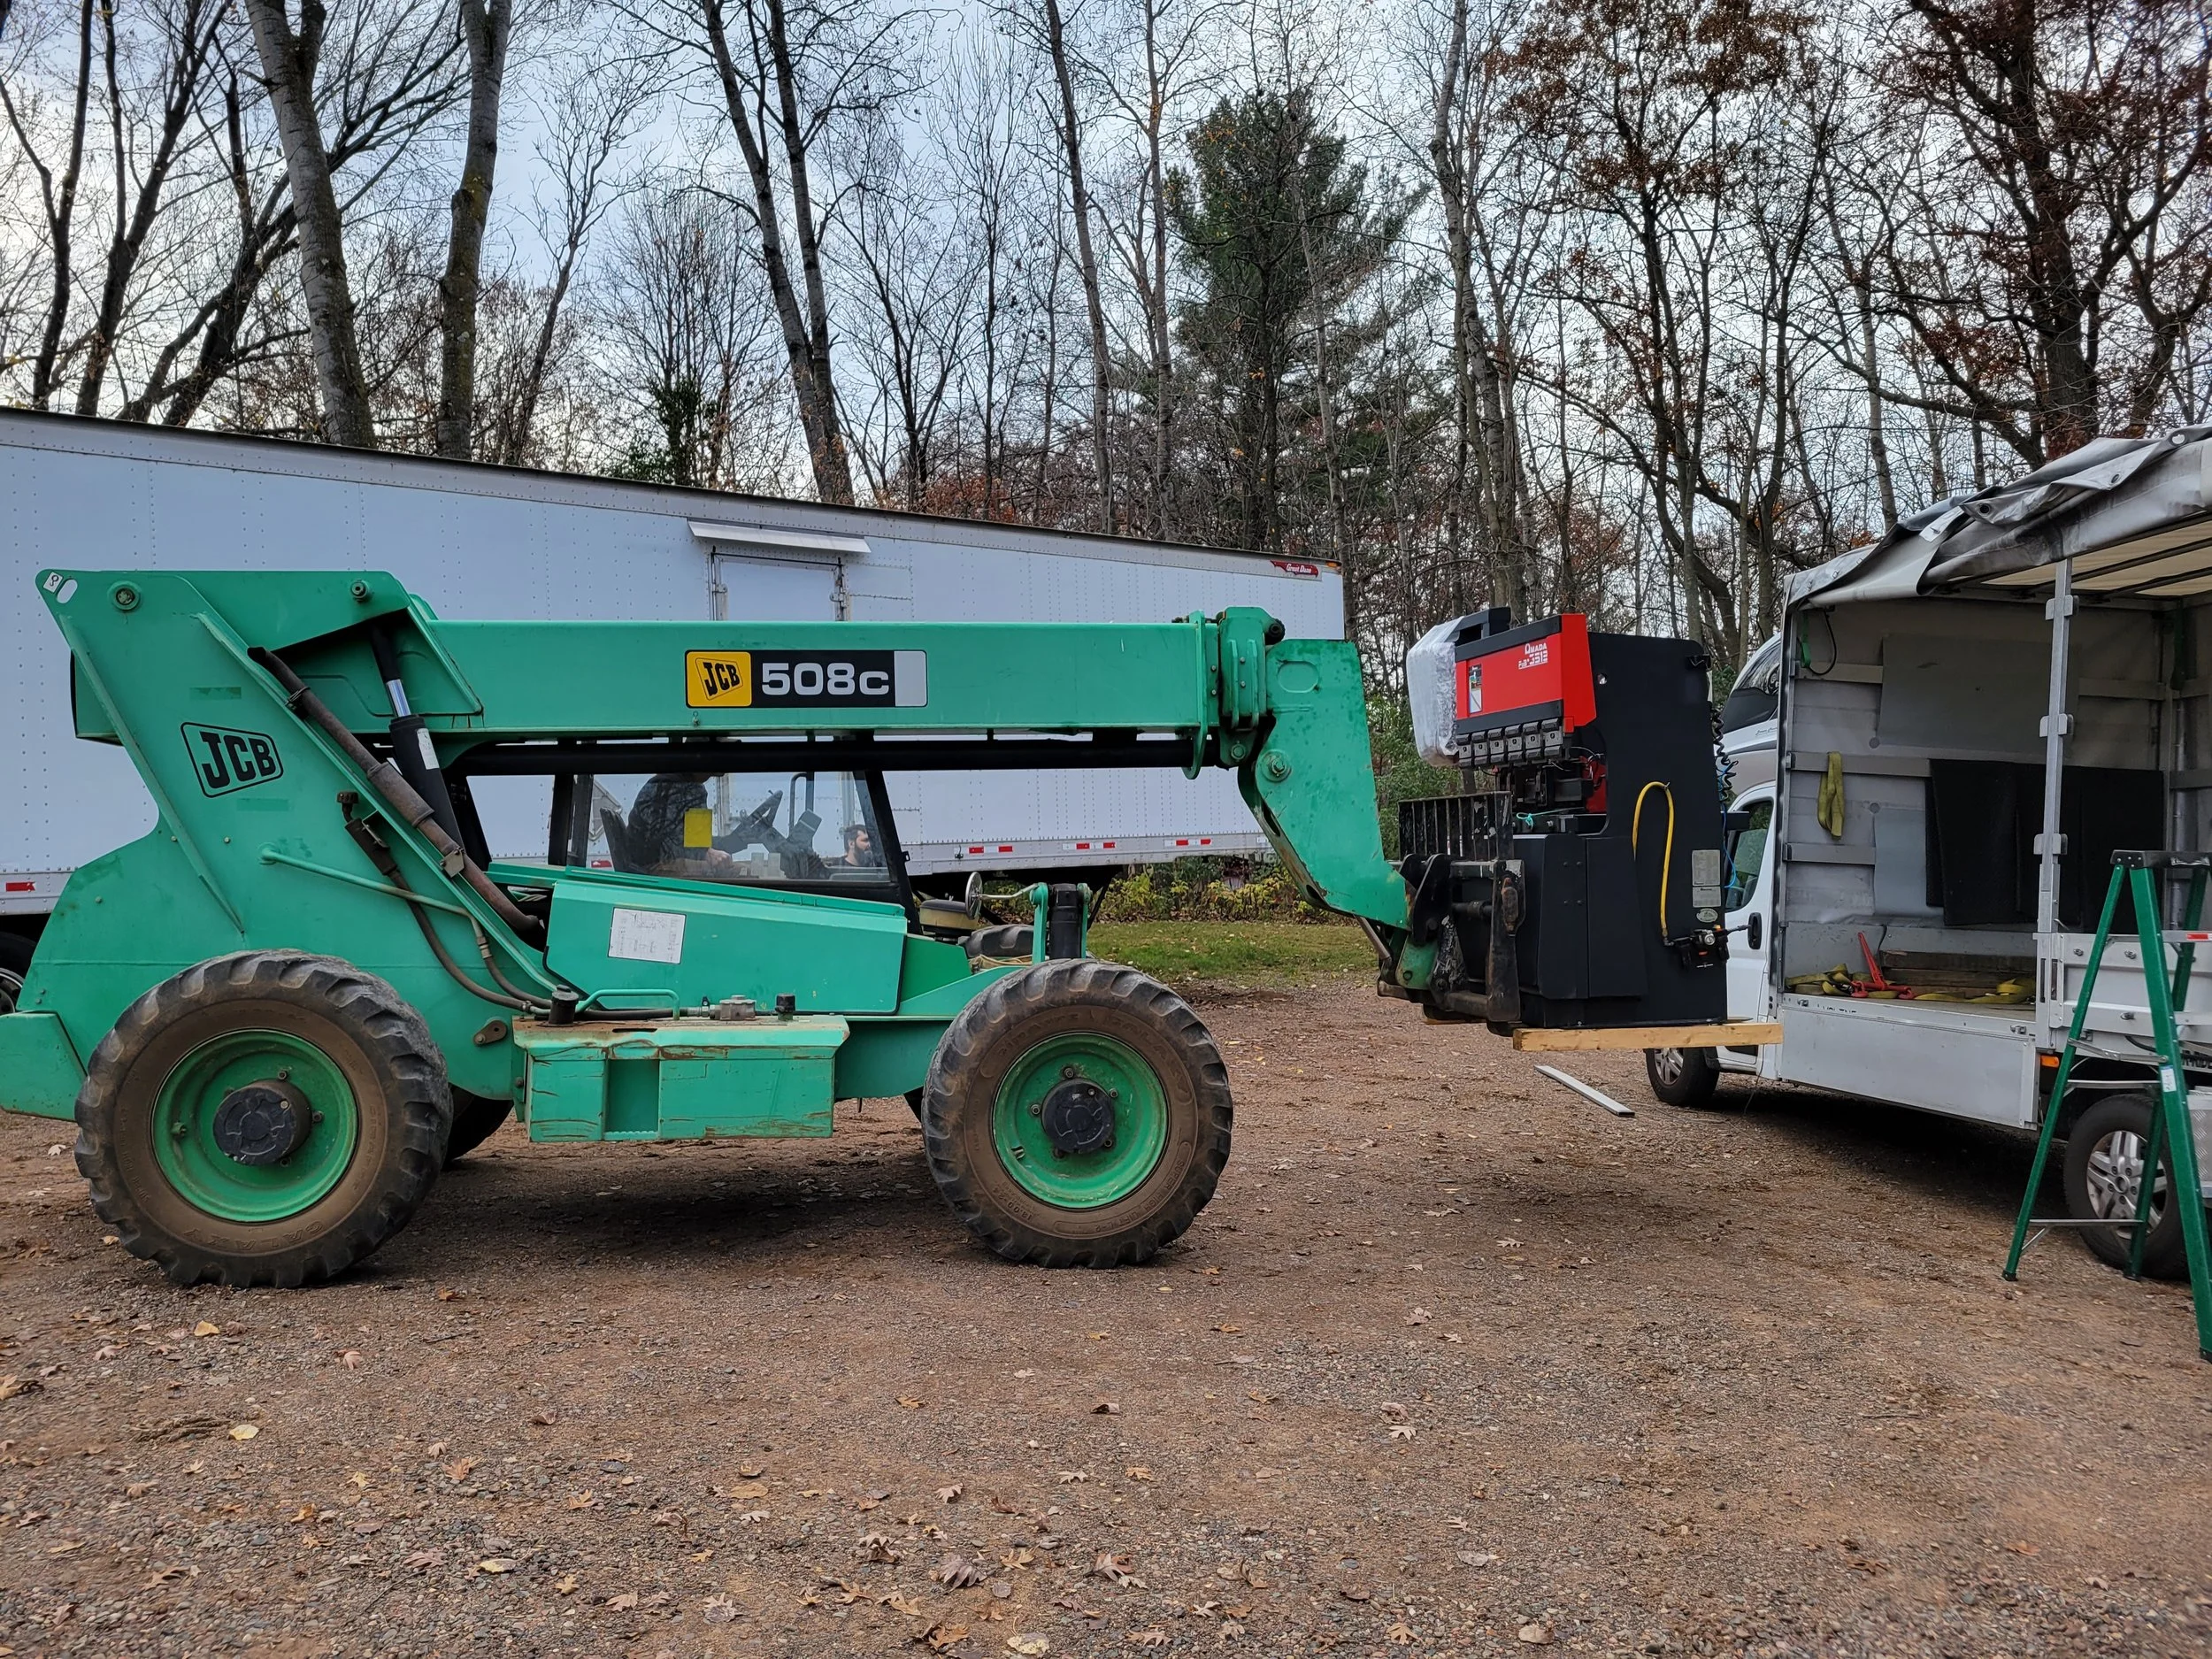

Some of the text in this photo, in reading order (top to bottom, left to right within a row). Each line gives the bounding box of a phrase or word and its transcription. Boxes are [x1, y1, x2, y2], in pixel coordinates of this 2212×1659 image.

[703, 661, 741, 697] JCB
[199, 731, 276, 789] JCB
[183, 1220, 325, 1251] GALAXY
